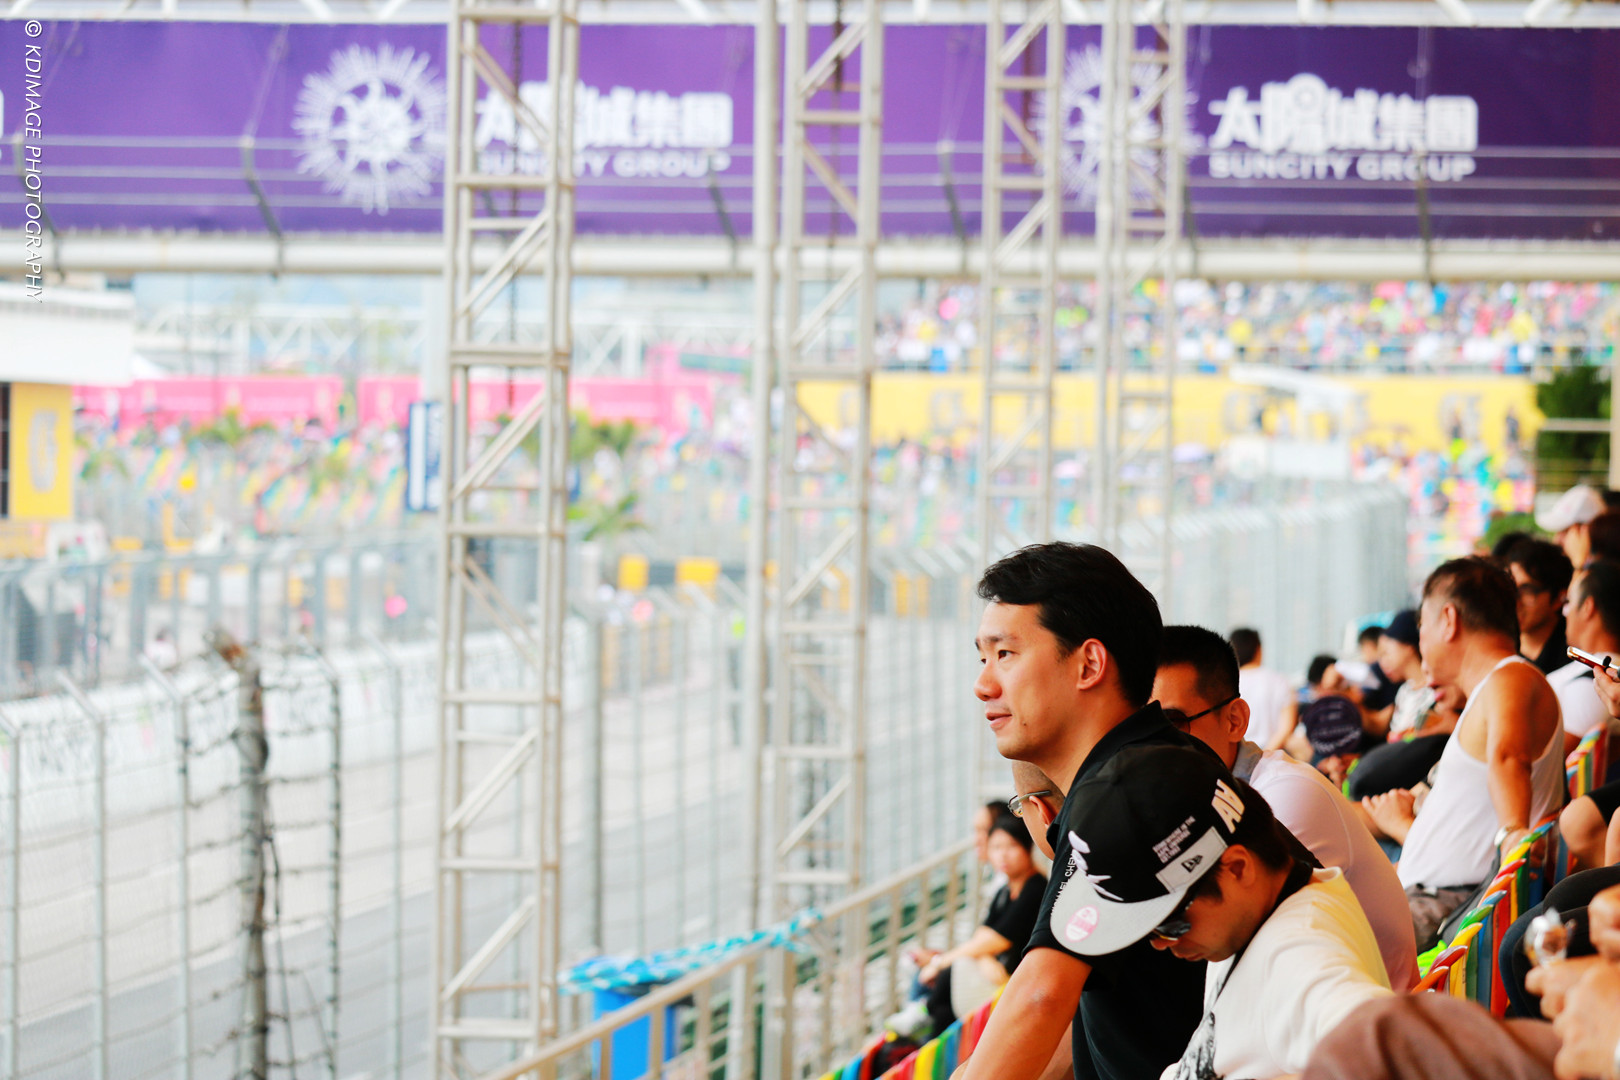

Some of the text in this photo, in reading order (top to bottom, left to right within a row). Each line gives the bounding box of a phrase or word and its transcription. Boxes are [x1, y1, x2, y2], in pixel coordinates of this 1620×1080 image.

[613, 149, 731, 178] GROUP
[1208, 151, 1476, 182] SUNCITY GROUP
